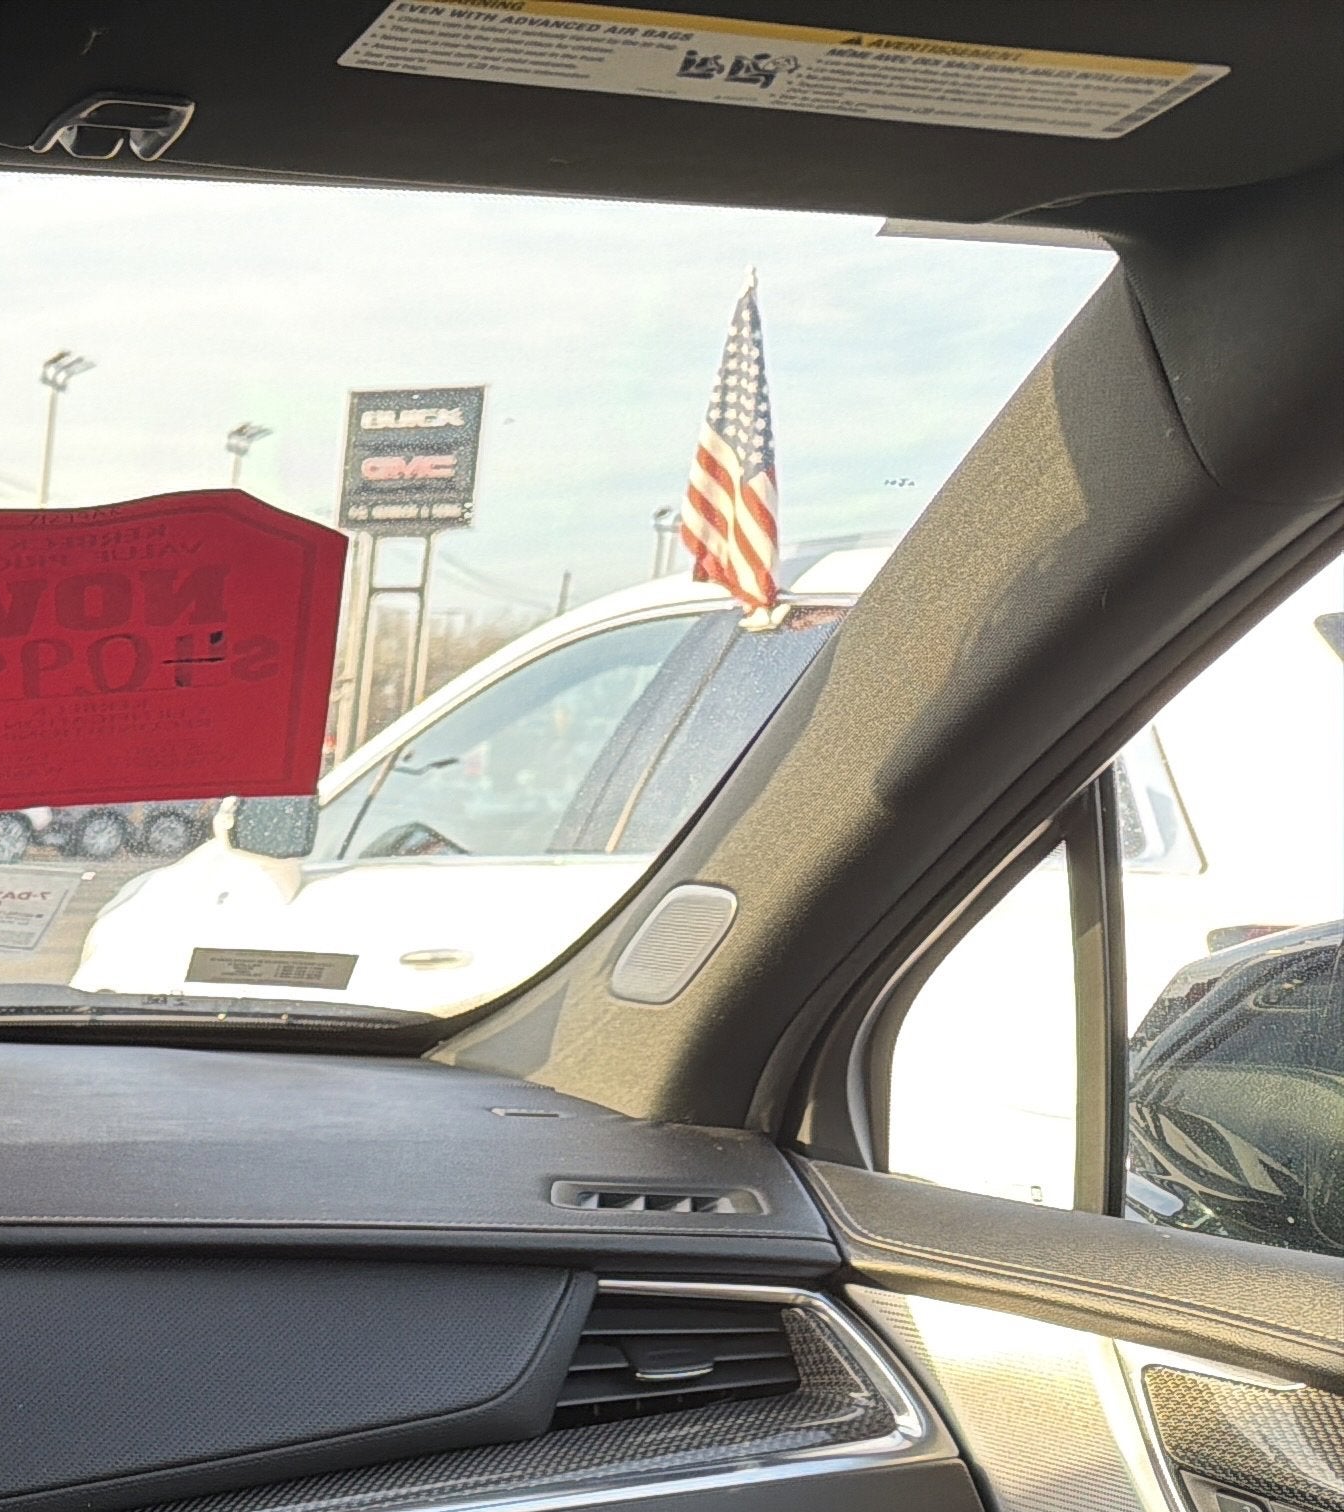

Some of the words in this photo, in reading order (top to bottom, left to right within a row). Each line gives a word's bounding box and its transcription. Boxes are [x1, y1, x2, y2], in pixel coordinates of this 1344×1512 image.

[396, 3, 446, 15] EVEN
[450, 9, 498, 21] WITH
[499, 15, 601, 32] ADVANCED
[603, 25, 639, 36] AIR
[641, 29, 694, 41] BAGS
[362, 455, 457, 481] GMC
